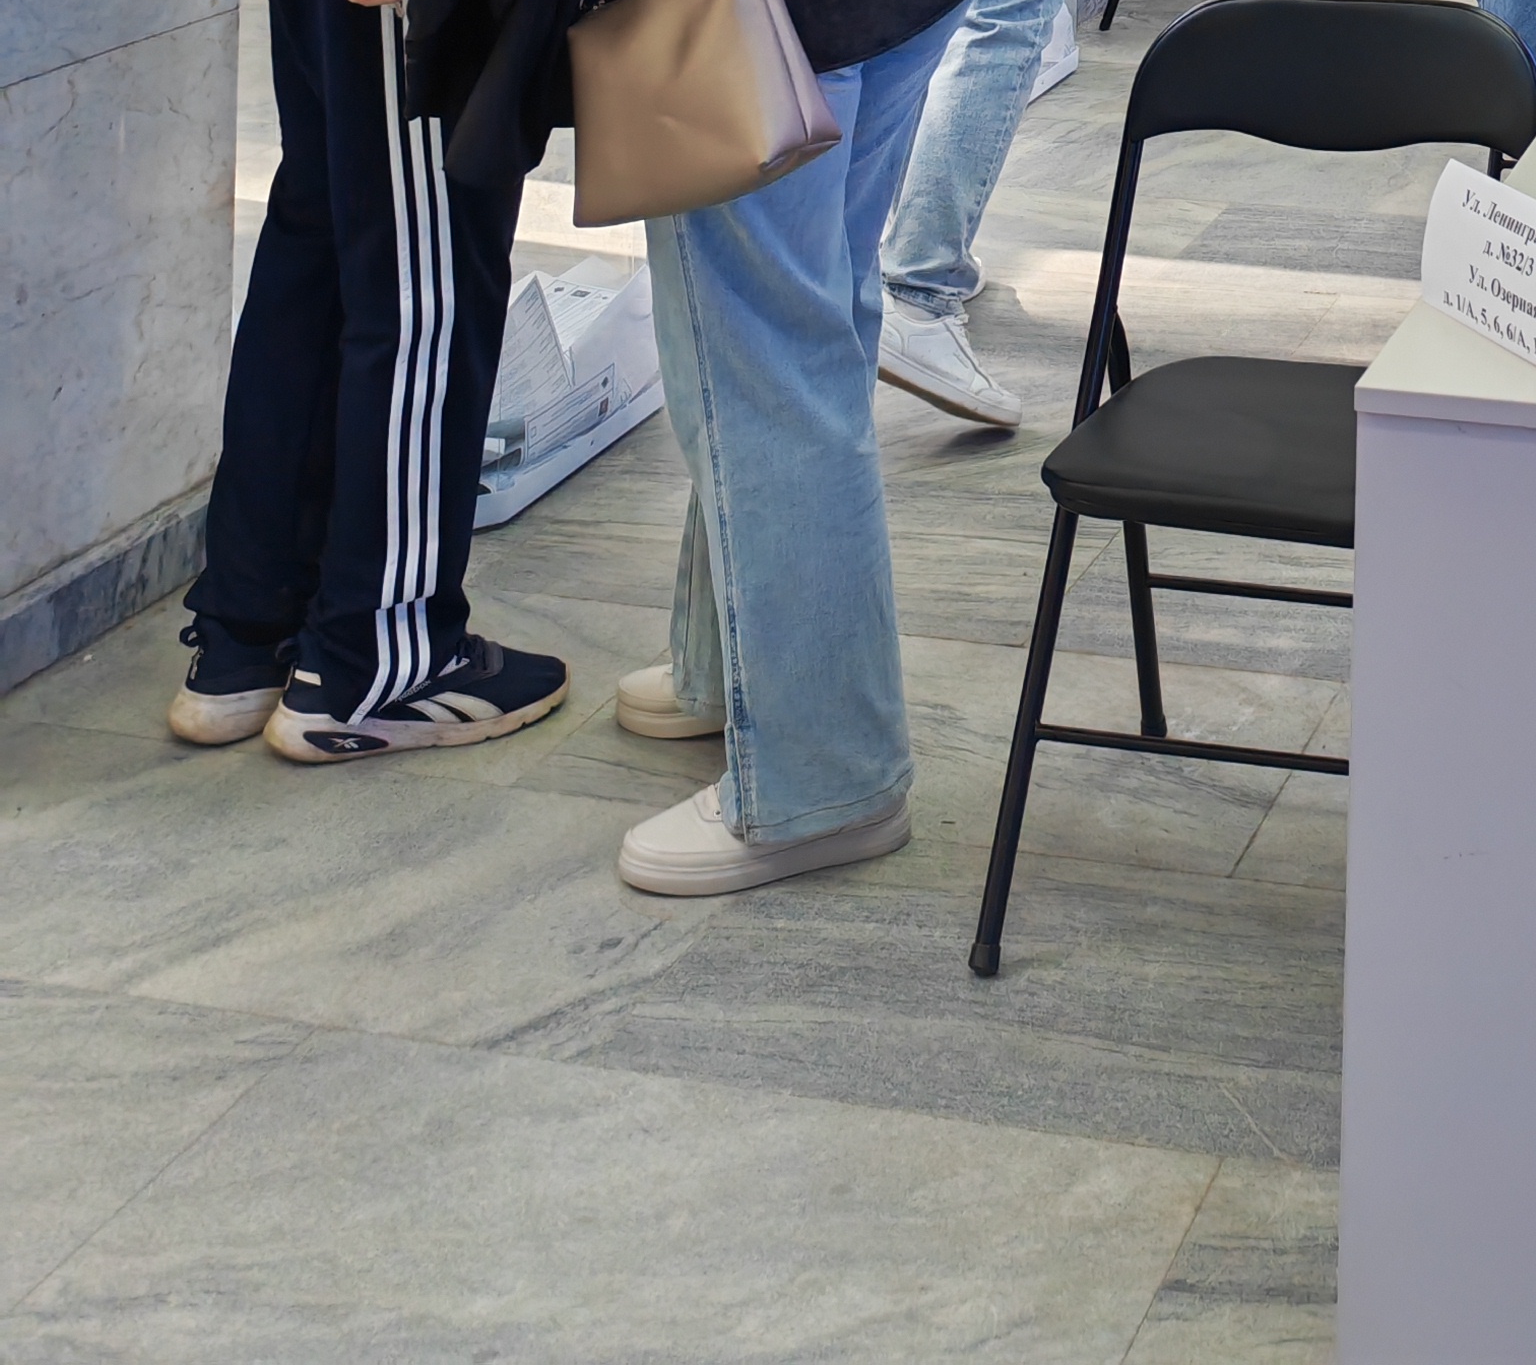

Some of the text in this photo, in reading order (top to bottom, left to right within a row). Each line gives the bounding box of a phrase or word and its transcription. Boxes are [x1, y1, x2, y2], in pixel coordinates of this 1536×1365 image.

[1462, 189, 1481, 215] Ул.
[1482, 240, 1535, 277] д. №32/3
[1468, 265, 1488, 293] Ул.
[1443, 290, 1453, 307] д.
[1456, 294, 1478, 324] 1/А,
[1480, 309, 1491, 331] 5,
[1493, 316, 1504, 339] 6,
[1506, 322, 1531, 353] 6/А,
